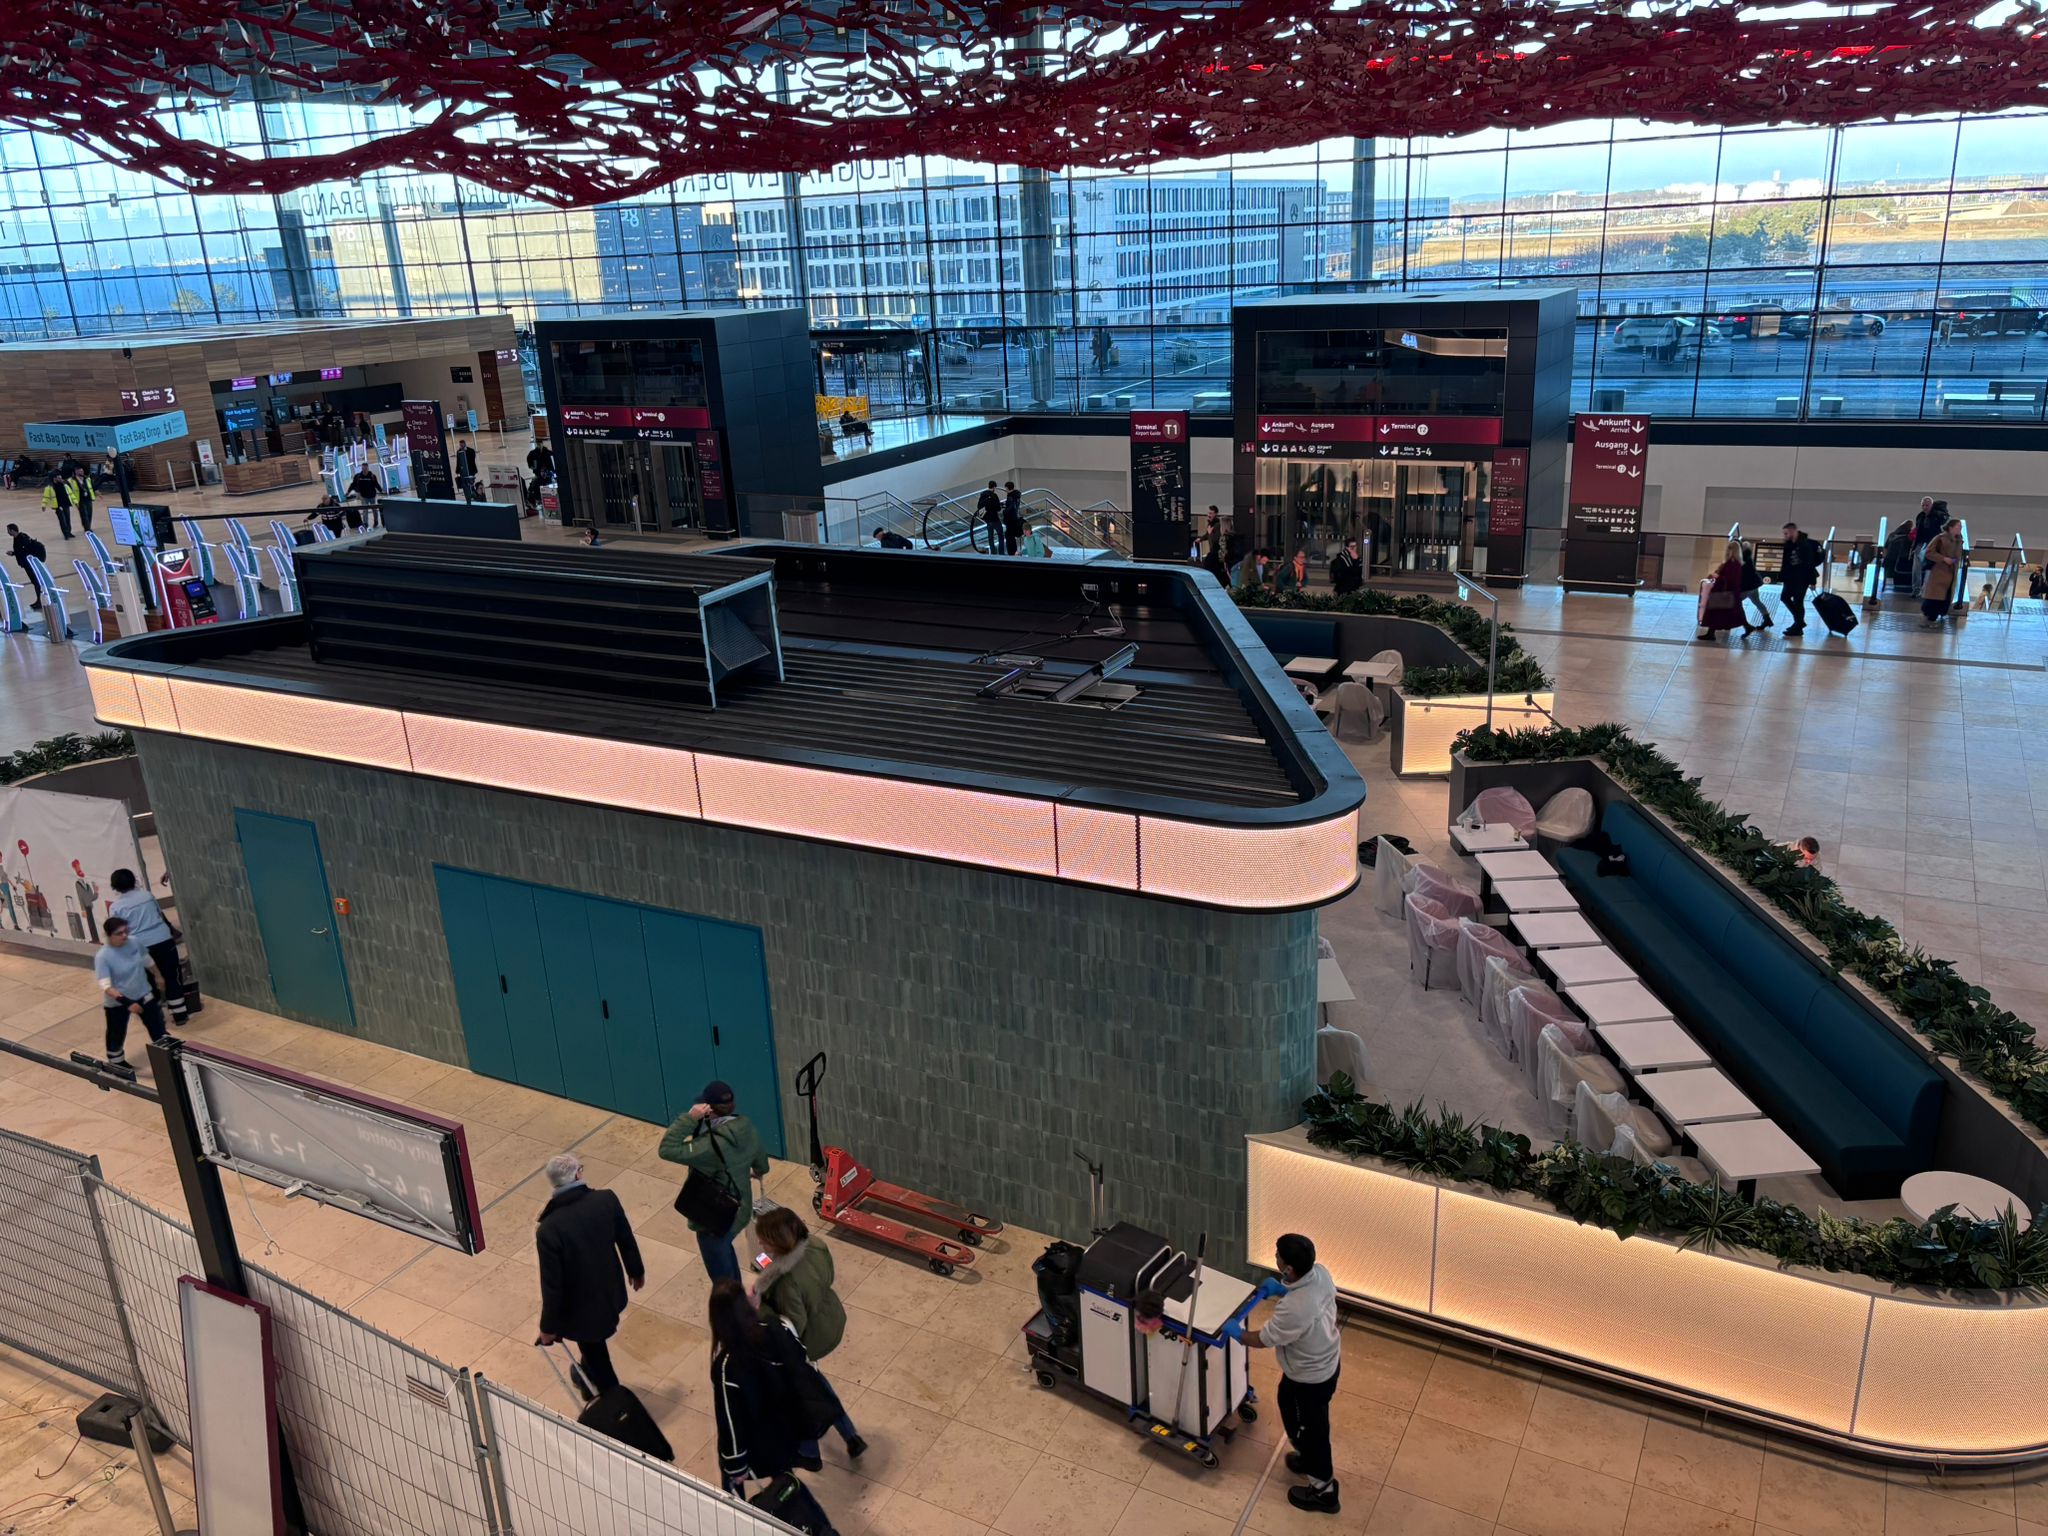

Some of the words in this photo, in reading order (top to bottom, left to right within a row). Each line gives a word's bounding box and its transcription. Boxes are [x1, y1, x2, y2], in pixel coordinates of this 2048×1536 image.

[510, 348, 518, 362] 3
[130, 391, 139, 407] 3
[164, 387, 176, 404] 3
[1310, 422, 1335, 430] Ausgang
[1598, 418, 1631, 427] Ankunft
[1164, 424, 1178, 435] T1
[29, 432, 44, 443] Fast
[45, 434, 60, 447] Bag
[59, 434, 81, 447] Drop
[120, 433, 133, 446] Fast
[132, 430, 146, 443] Bag
[145, 426, 161, 441] Drop
[1595, 441, 1629, 450] Ausgang
[1415, 447, 1432, 457] 3-4
[1510, 457, 1521, 466] T1
[163, 551, 184, 563] ATM
